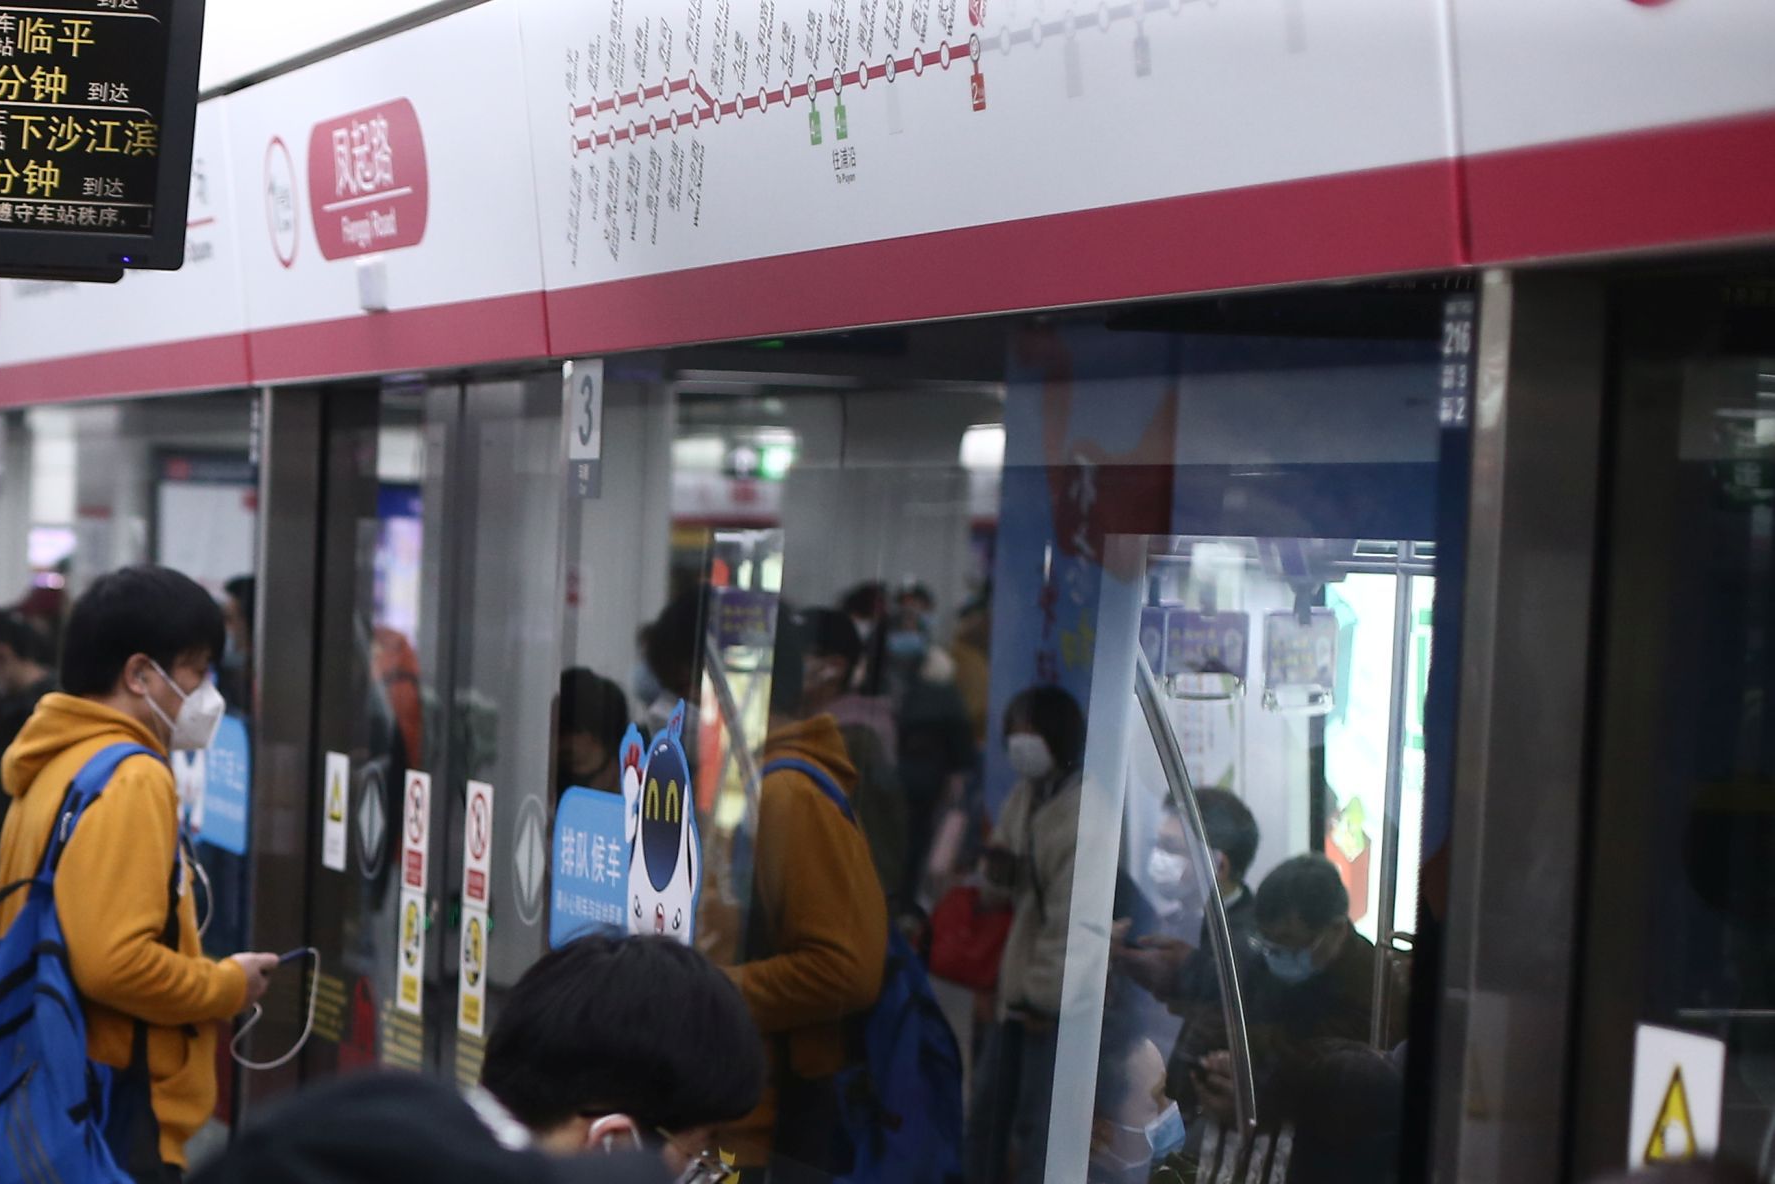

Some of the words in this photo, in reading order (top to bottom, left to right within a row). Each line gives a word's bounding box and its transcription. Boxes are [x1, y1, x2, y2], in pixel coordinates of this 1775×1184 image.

[16, 16, 96, 58] 临平
[86, 82, 130, 103] 到达
[10, 114, 159, 156] 下沙江滨
[81, 176, 125, 199] 到达
[578, 374, 593, 446] 3
